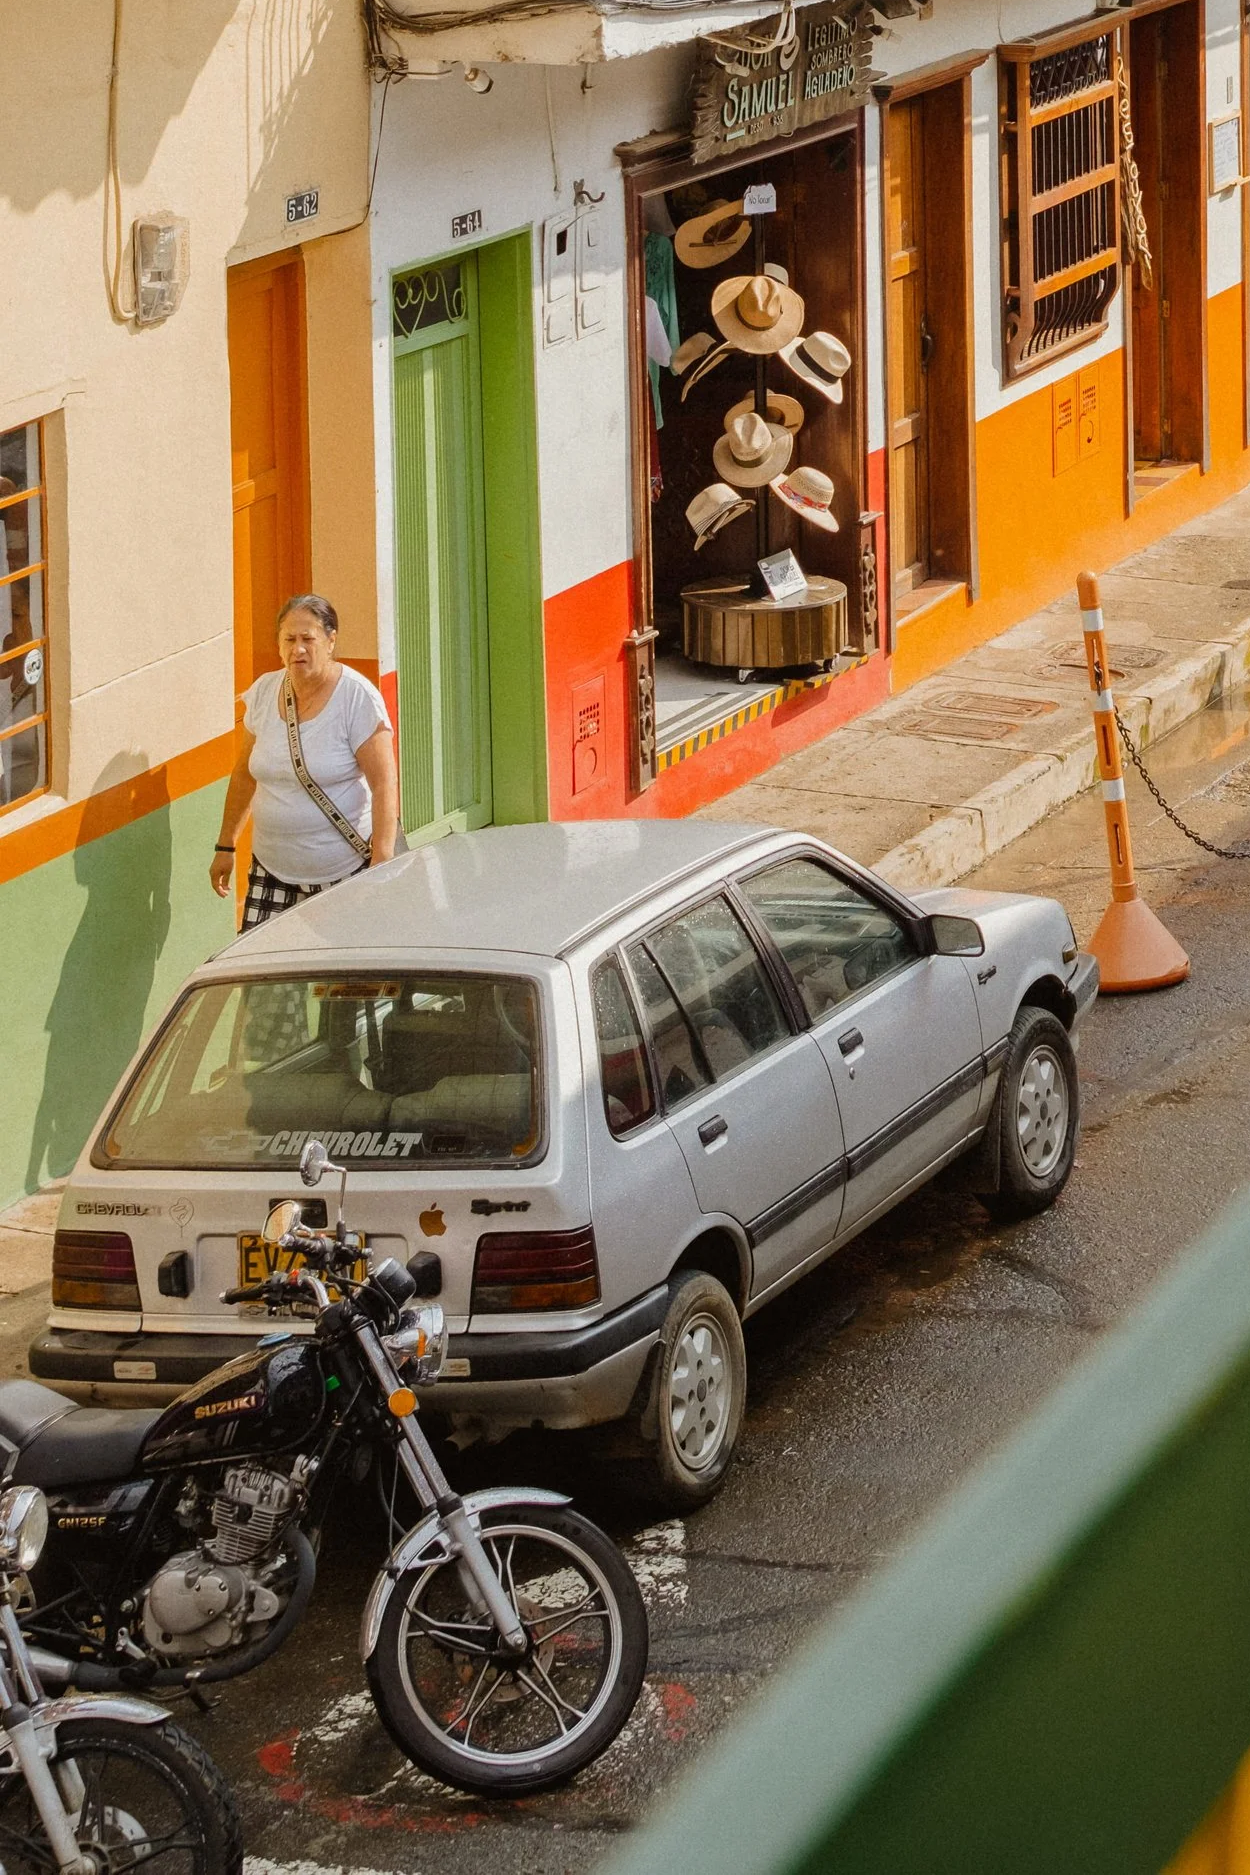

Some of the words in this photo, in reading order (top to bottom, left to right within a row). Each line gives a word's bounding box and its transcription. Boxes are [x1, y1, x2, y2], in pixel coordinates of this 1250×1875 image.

[810, 42, 854, 70] SOMBRERO
[804, 60, 856, 101] AGUADEÑO
[724, 70, 795, 128] SAMUEL
[287, 192, 318, 221] 5-62
[453, 210, 482, 239] 5-64
[194, 1394, 257, 1420] SUZUKI
[57, 1516, 107, 1529] GN125F
